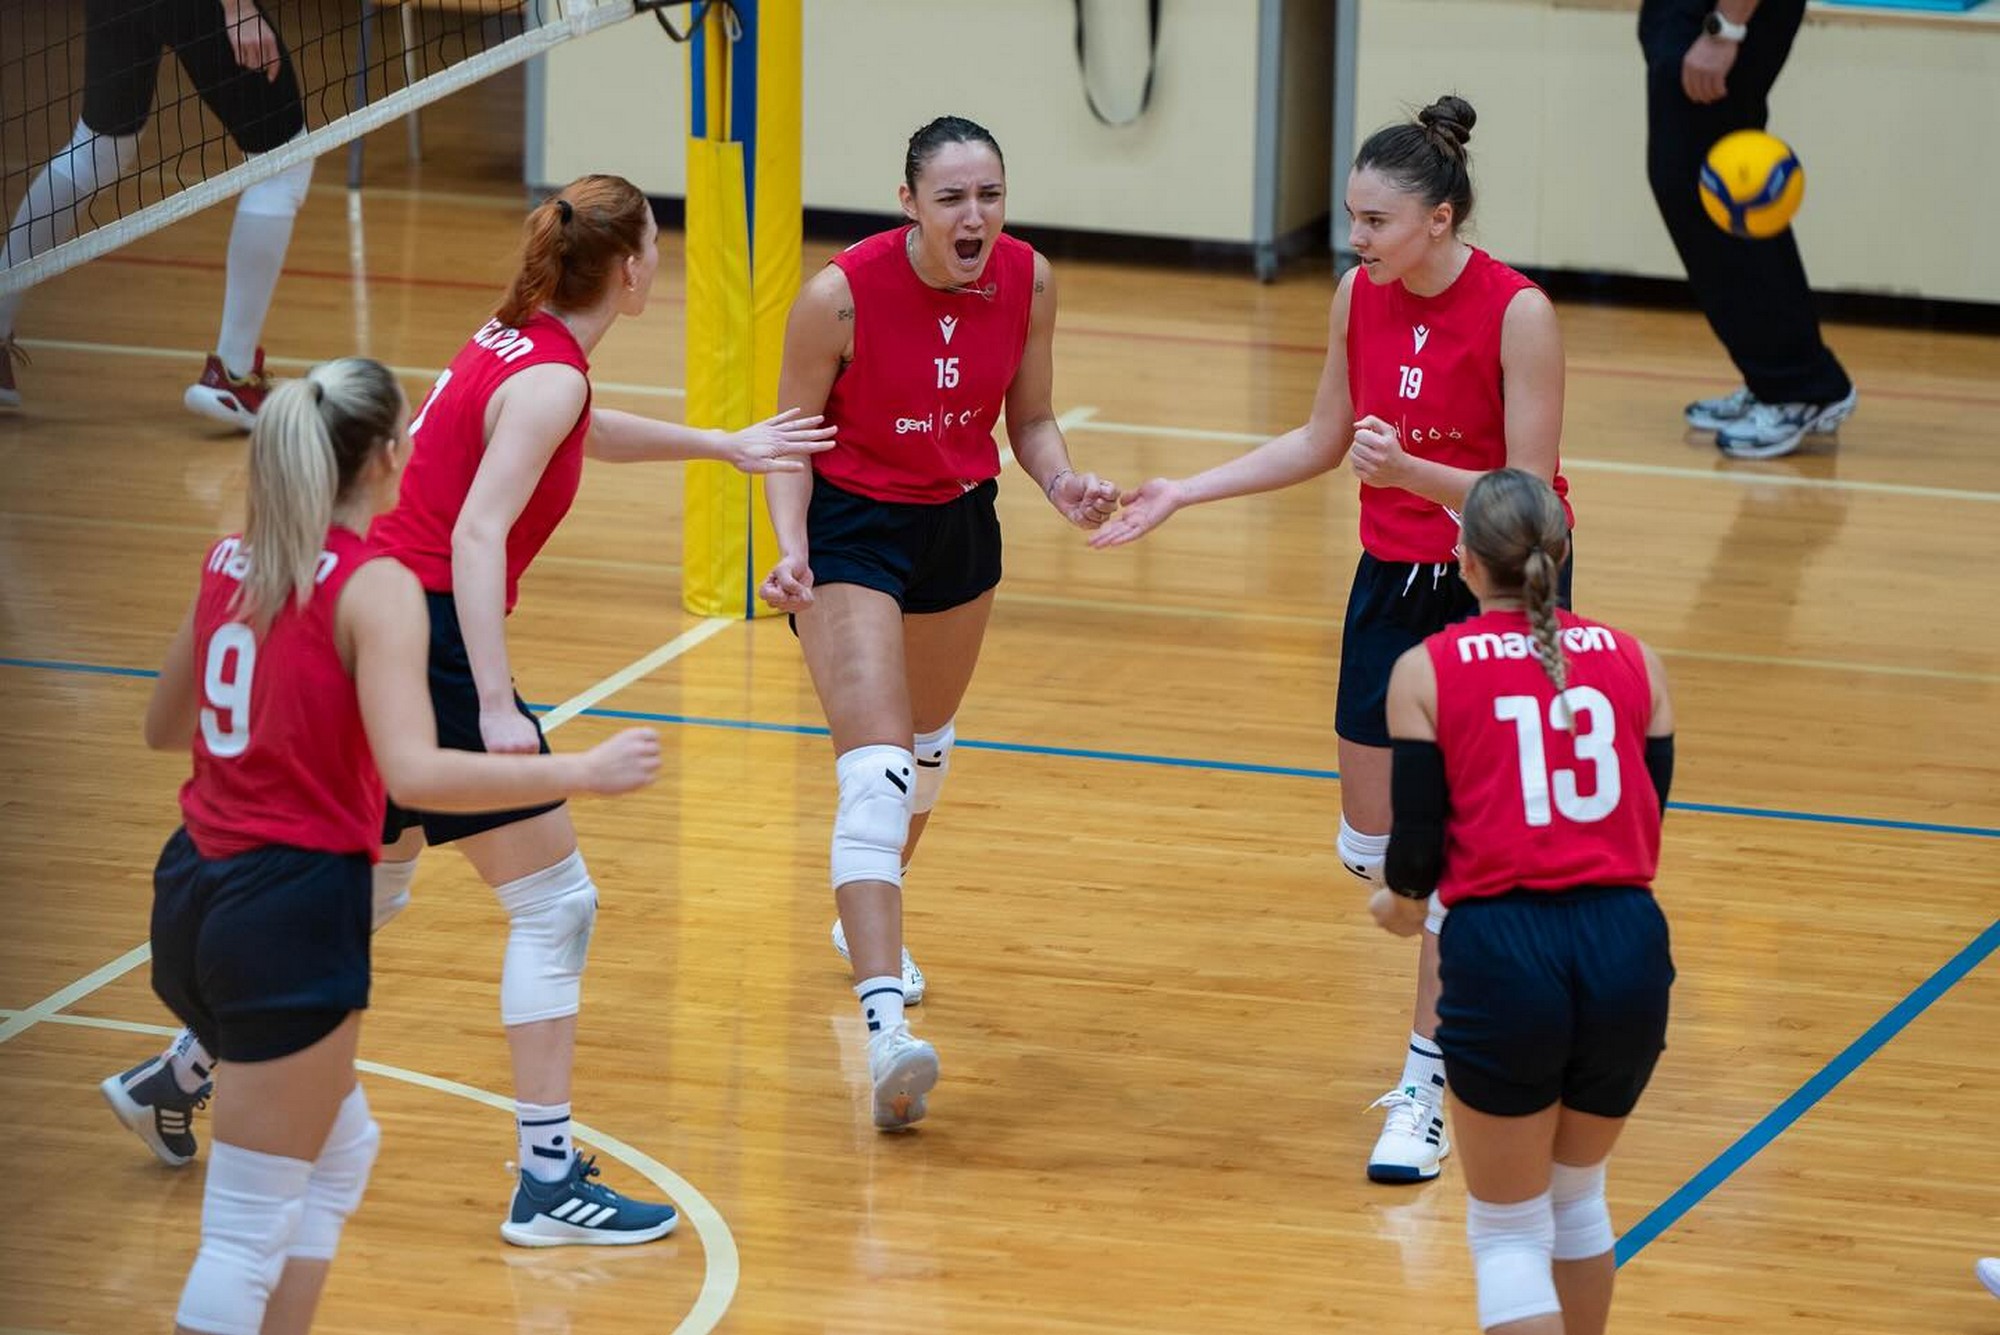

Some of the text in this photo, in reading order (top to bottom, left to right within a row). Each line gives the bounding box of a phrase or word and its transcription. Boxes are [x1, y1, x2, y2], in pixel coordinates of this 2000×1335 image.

[934, 357, 960, 389] 15
[1399, 365, 1423, 400] 19
[208, 537, 338, 582] man
[1457, 626, 1616, 664] macon
[200, 621, 256, 758] 9
[1494, 685, 1622, 827] 13
